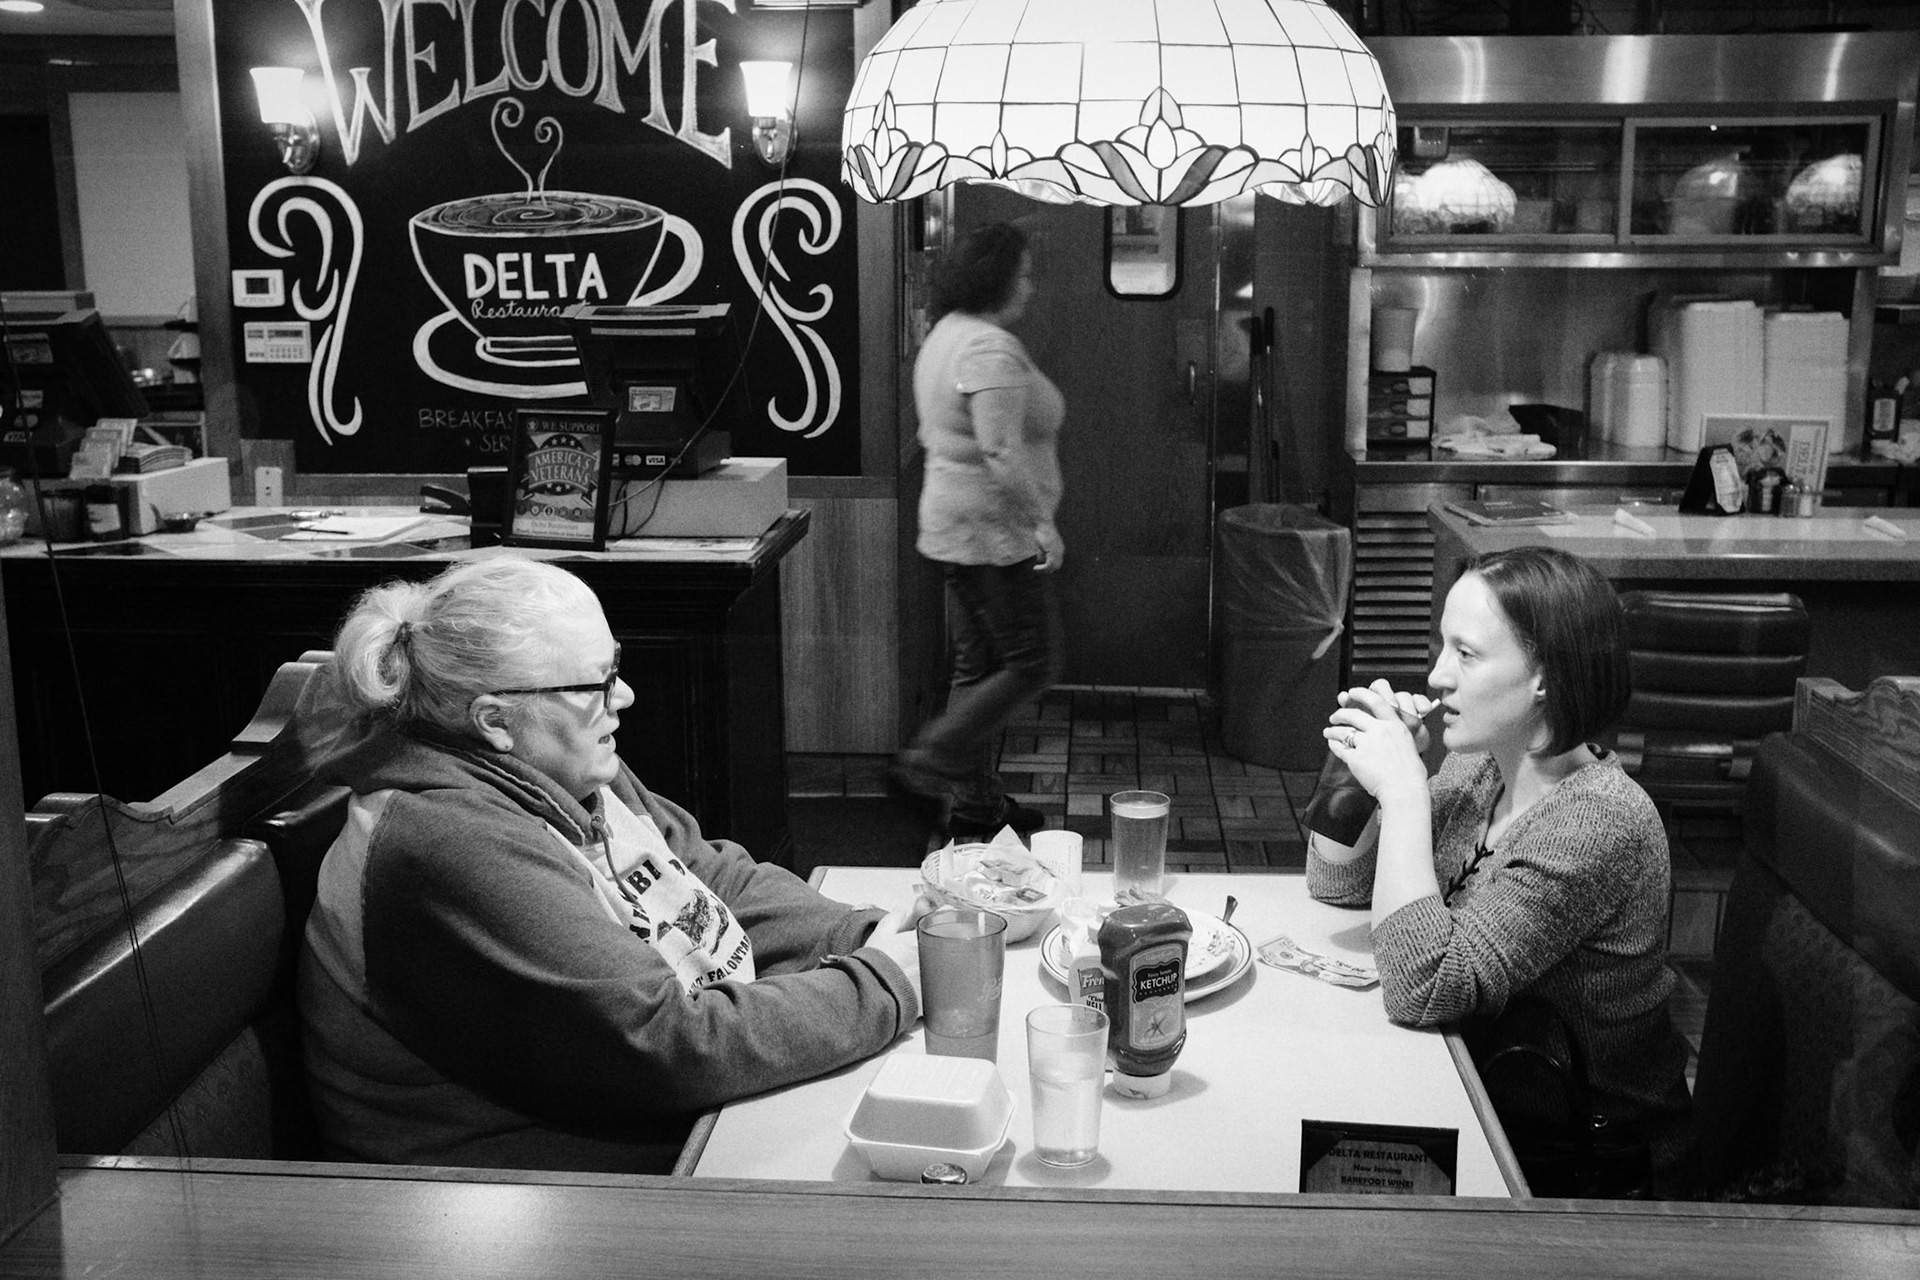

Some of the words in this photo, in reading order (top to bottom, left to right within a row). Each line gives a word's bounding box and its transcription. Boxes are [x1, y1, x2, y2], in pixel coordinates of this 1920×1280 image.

[295, 0, 736, 169] WELCOME
[463, 252, 608, 300] DELTA
[471, 299, 591, 319] Restaura
[542, 421, 557, 431] WE
[559, 422, 601, 433] SUPPORT
[534, 451, 592, 470] AMERICA'S
[530, 465, 591, 486] VETERANS
[1140, 972, 1178, 990] KETCHUP
[1328, 1147, 1361, 1159] DELTA
[1363, 1150, 1428, 1163] RESTAURANT
[1374, 1165, 1402, 1175] Serving
[1341, 1176, 1386, 1187] BAREFOOT
[1388, 1179, 1414, 1188] WINES
